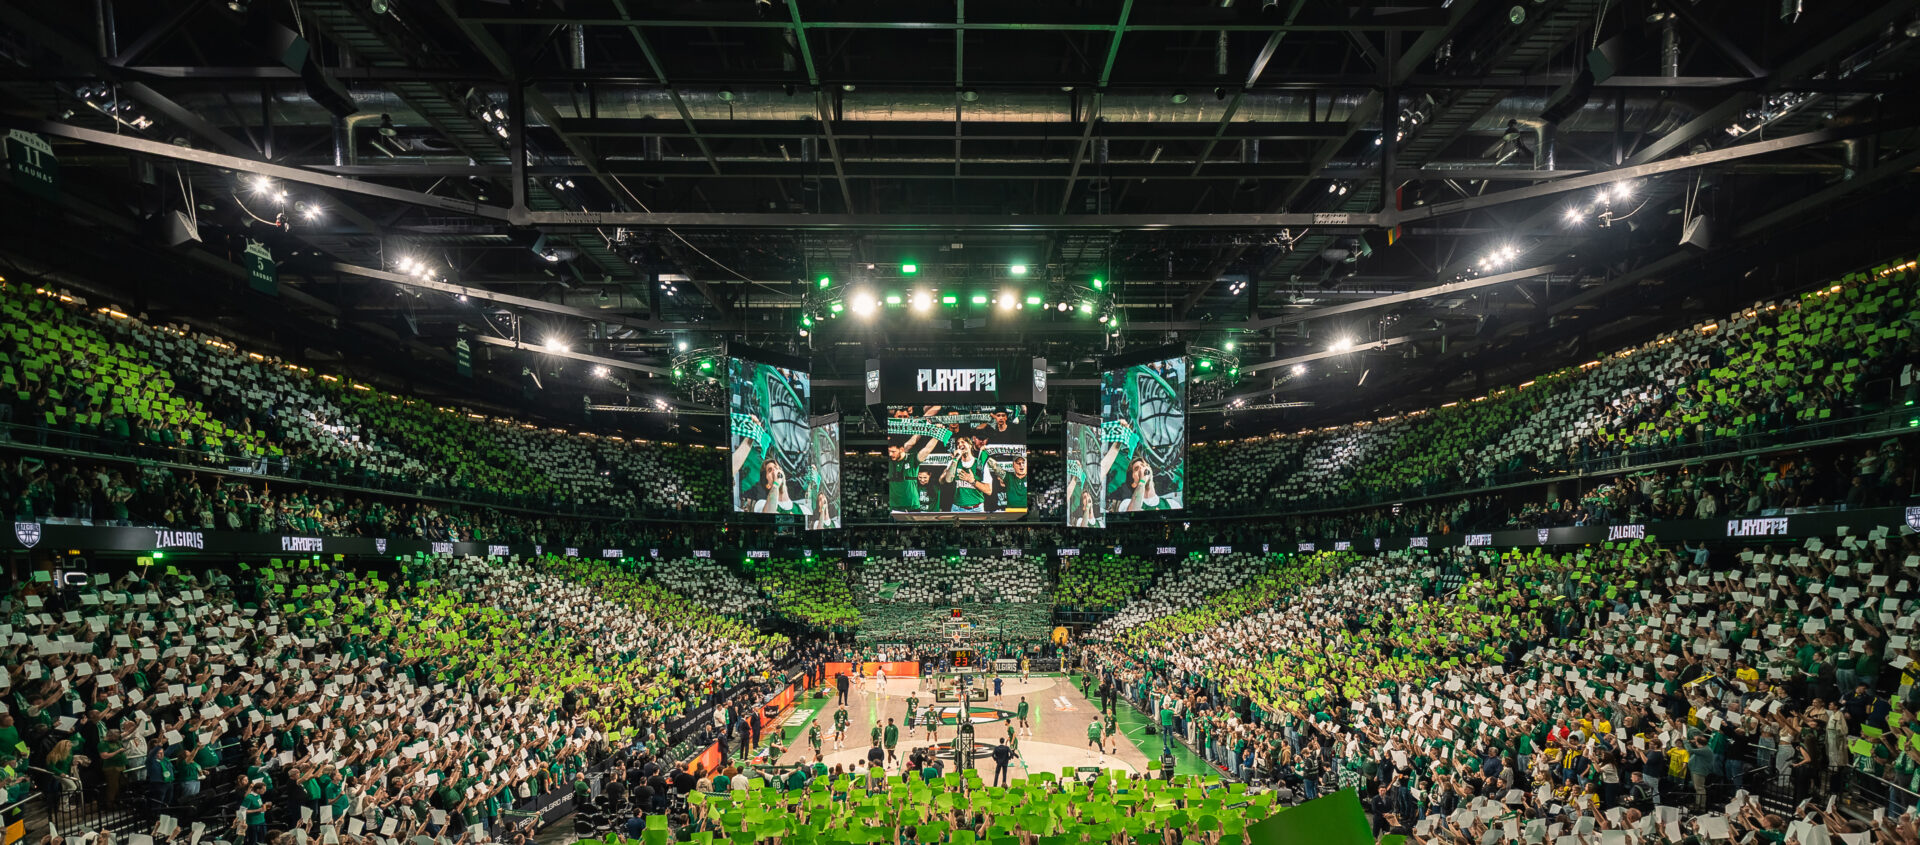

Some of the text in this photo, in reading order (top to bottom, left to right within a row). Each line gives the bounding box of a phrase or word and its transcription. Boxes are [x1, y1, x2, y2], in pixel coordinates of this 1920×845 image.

[24, 146, 42, 168] 11
[19, 163, 53, 183] KAUNAS
[257, 256, 264, 270] 5
[917, 368, 996, 392] PLAYOFFS
[1727, 517, 1789, 536] PLAYOFFS
[281, 536, 323, 551] PLAYOFFS
[1464, 533, 1492, 546] PLAYOFFS
[488, 545, 509, 556] PLAYOFFS
[954, 657, 968, 667] 23
[995, 663, 1017, 672] ALGIRIS
